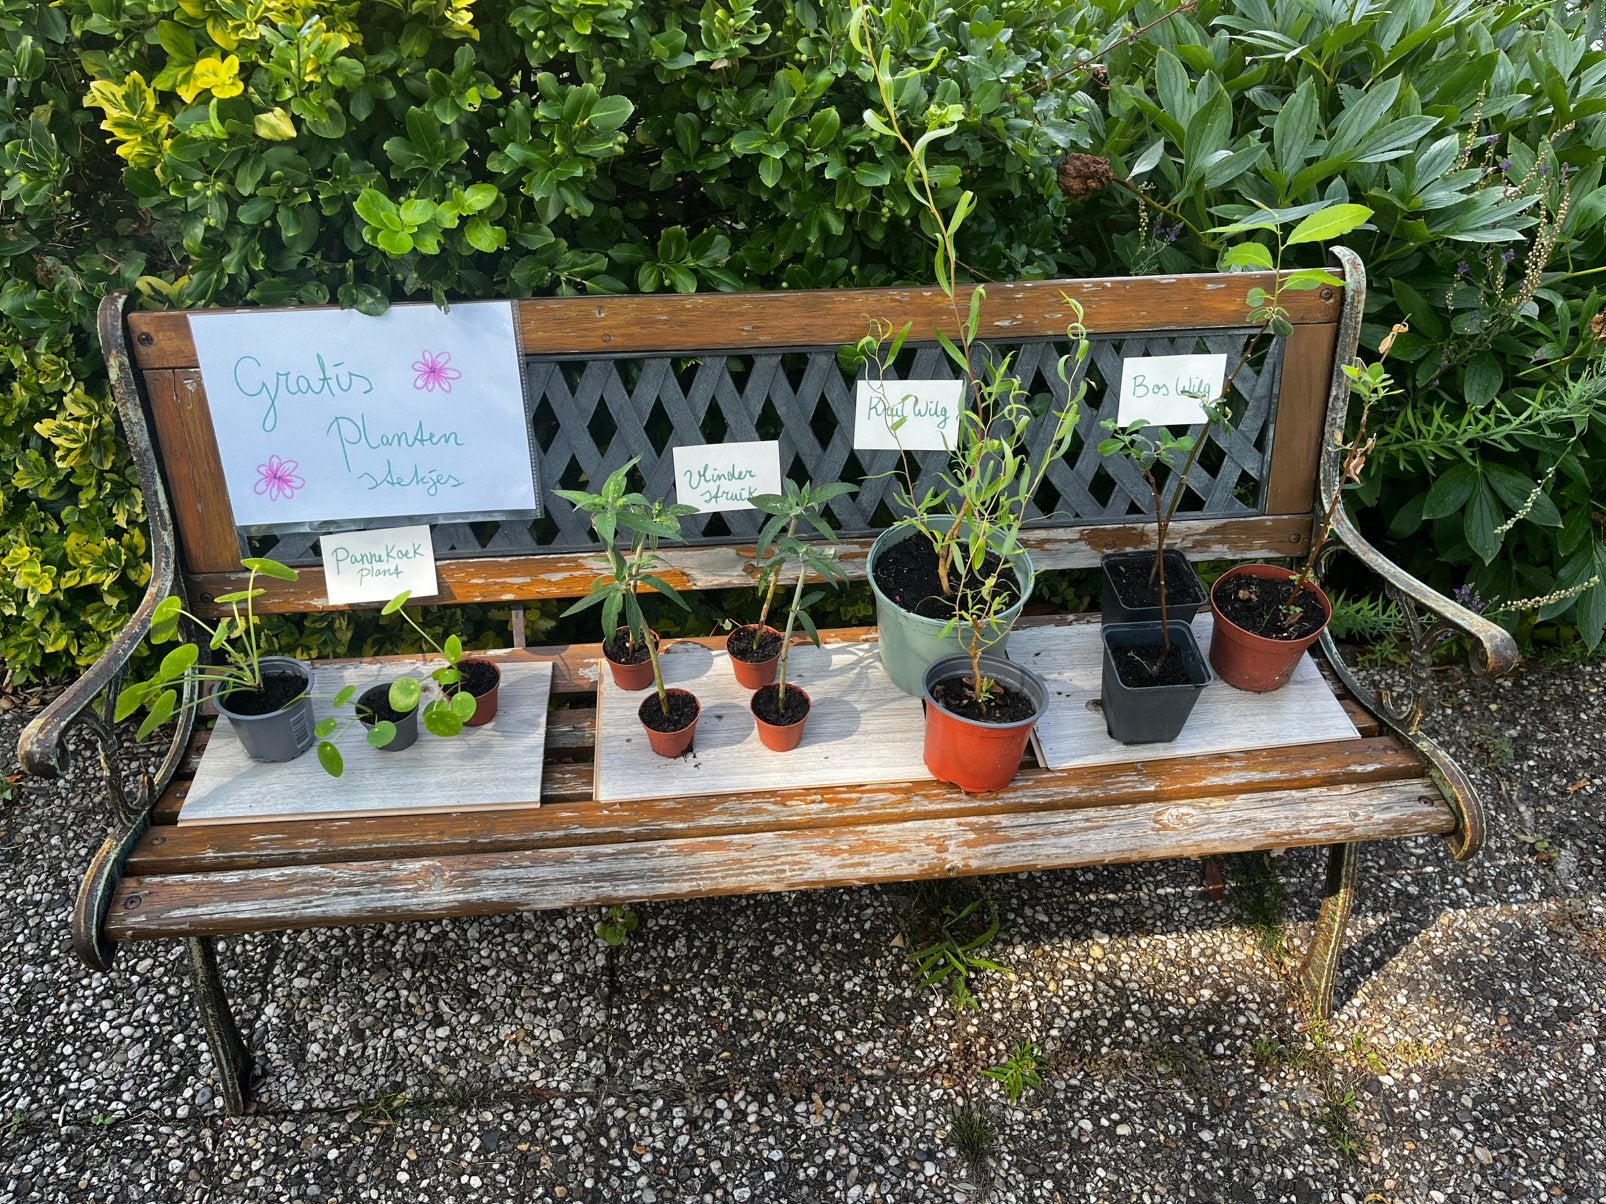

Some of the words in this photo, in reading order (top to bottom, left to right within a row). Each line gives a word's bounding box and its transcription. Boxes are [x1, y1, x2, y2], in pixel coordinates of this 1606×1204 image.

[234, 353, 374, 432] Gratis
[1132, 374, 1169, 398] Bos
[1175, 376, 1211, 407] Wilg
[912, 400, 950, 429] Wilg
[357, 459, 466, 496] stekjes
[684, 463, 756, 489] Vlinder
[357, 564, 404, 586] plant
